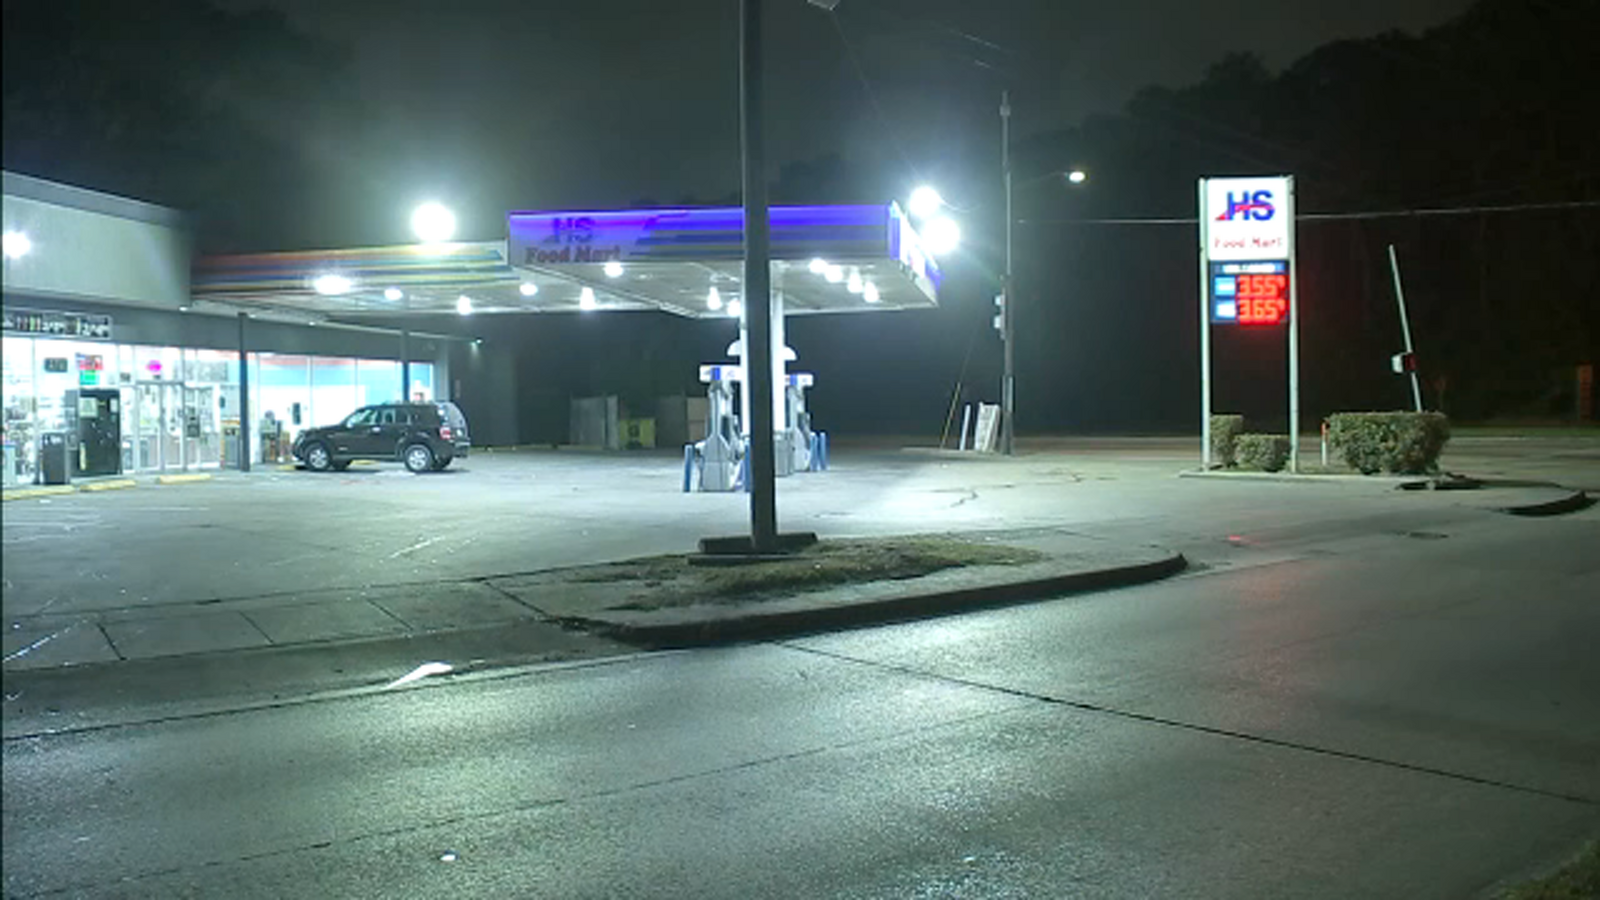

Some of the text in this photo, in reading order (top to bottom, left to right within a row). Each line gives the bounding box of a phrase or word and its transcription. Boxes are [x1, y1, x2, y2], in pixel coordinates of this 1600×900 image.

[1225, 189, 1276, 221] HS
[552, 216, 596, 243] HS
[525, 245, 621, 263] Food Mart
